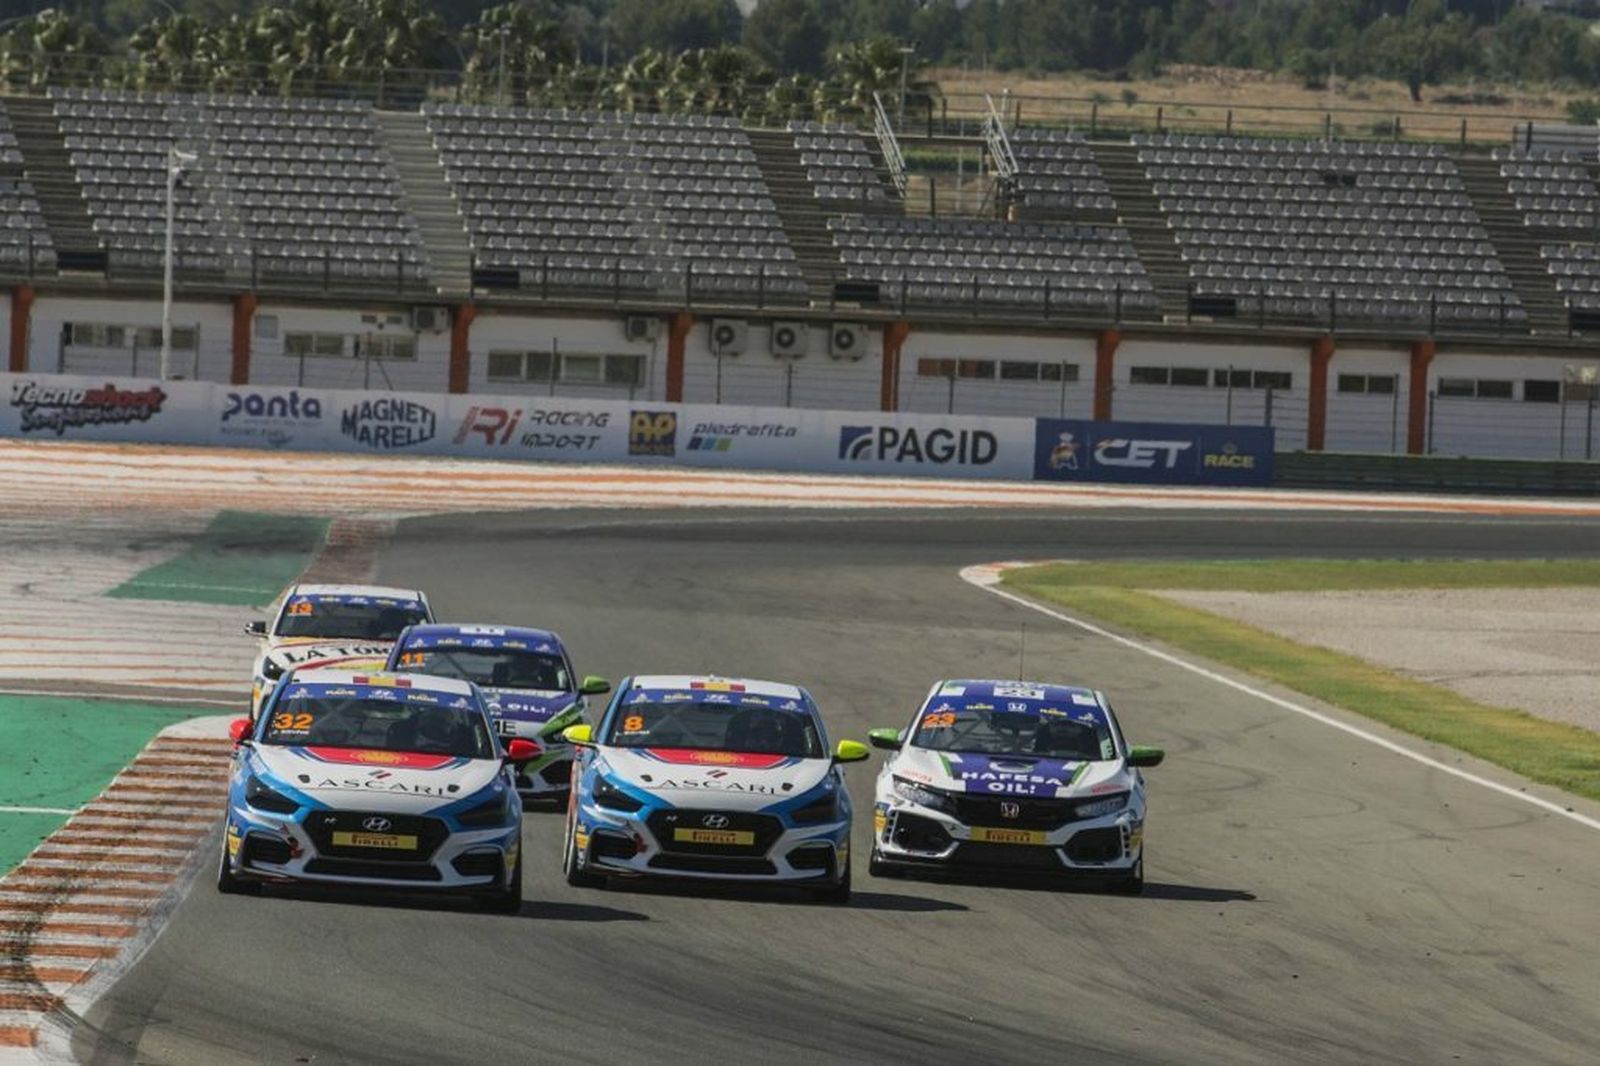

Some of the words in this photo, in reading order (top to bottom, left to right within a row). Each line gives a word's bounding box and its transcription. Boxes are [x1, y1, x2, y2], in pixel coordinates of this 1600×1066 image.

[221, 390, 321, 421] panta
[692, 421, 798, 438] piedrafita
[878, 426, 998, 465] PAGID
[1094, 438, 1192, 469] CET
[1204, 453, 1255, 469] RACE
[402, 652, 424, 664] 11
[275, 712, 314, 730] 32
[624, 715, 644, 732] 8
[318, 778, 444, 796] ASCARI
[658, 778, 776, 796] ASCARI
[961, 771, 1063, 786] HAFESA
[988, 781, 1036, 795] OIL!
[352, 833, 399, 846] PIRELLI
